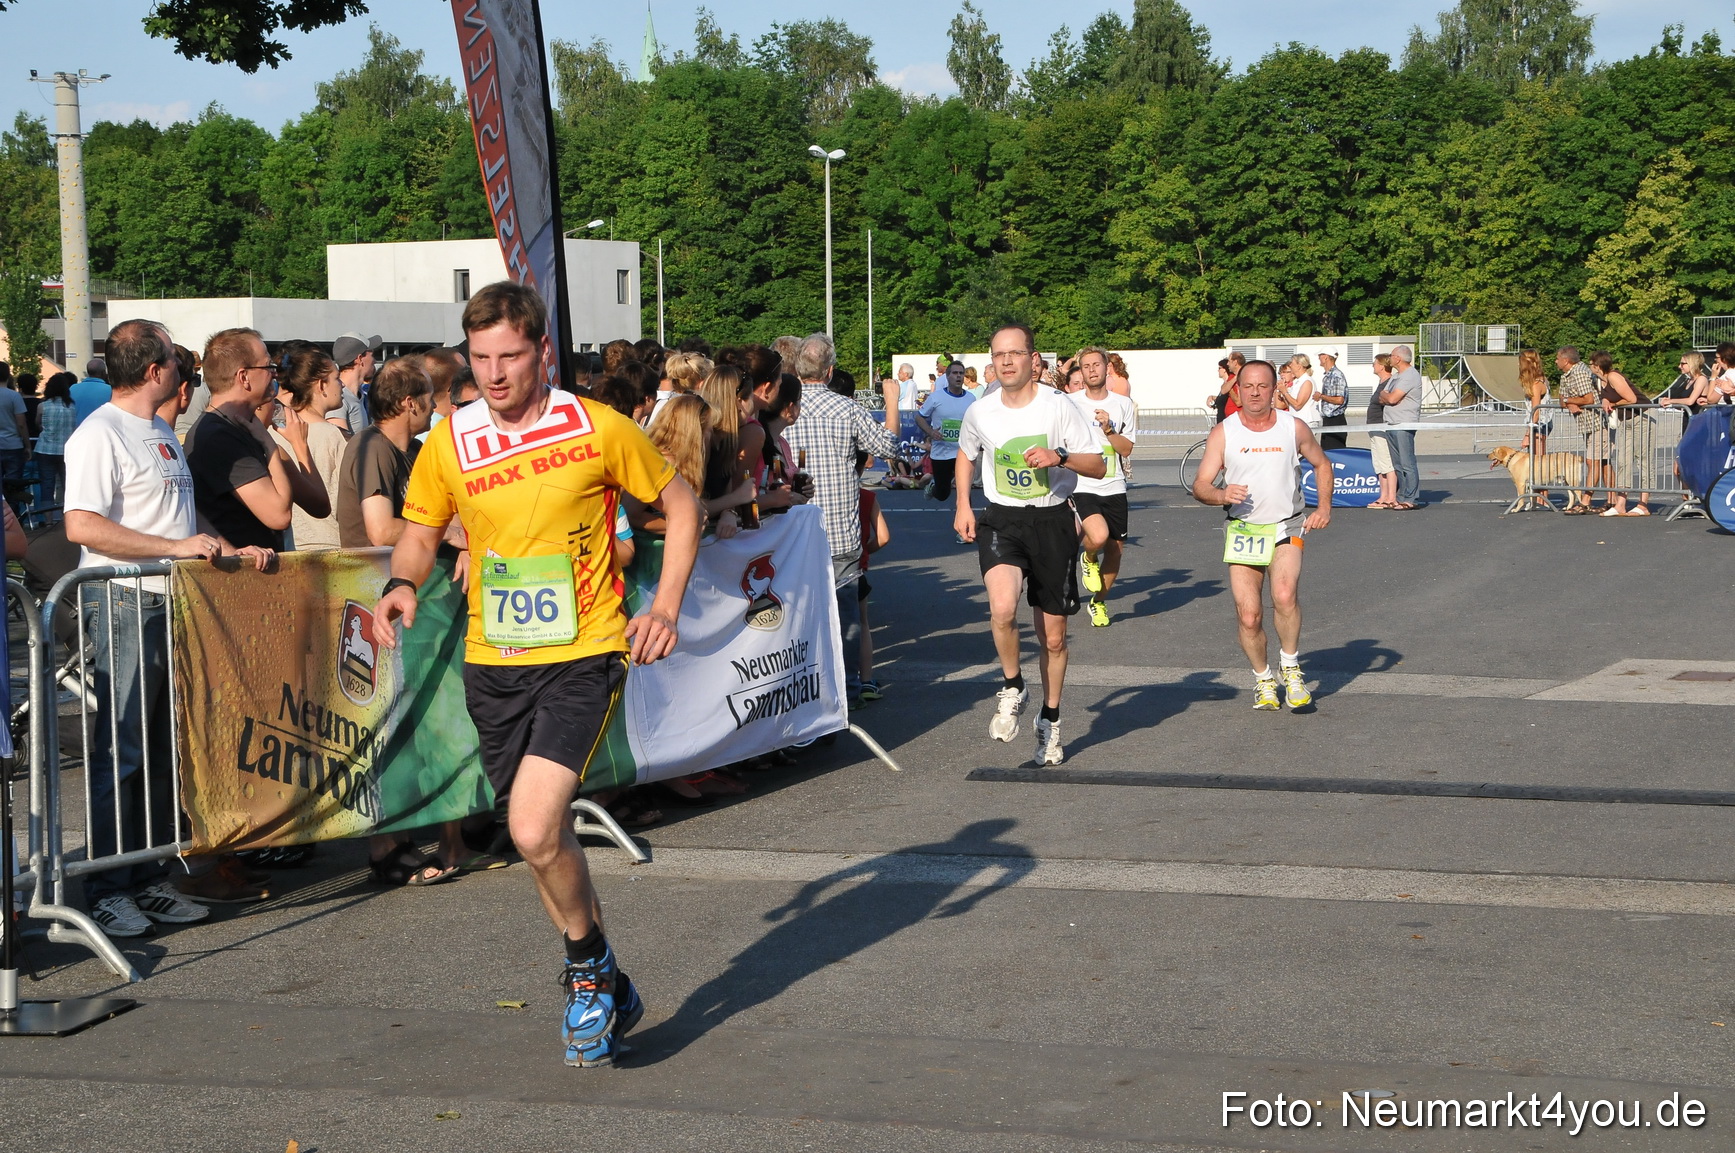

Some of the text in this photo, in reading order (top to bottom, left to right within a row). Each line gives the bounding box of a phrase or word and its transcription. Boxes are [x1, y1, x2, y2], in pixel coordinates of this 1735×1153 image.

[943, 429, 960, 438] 508
[465, 443, 602, 497] MAX BÖGL
[1006, 468, 1033, 487] 96
[1333, 473, 1380, 488] sche
[1233, 535, 1265, 555] 511
[491, 588, 559, 624] 796
[755, 611, 777, 626] 1628
[731, 640, 807, 683] Neumarkter
[345, 674, 367, 698] 1628
